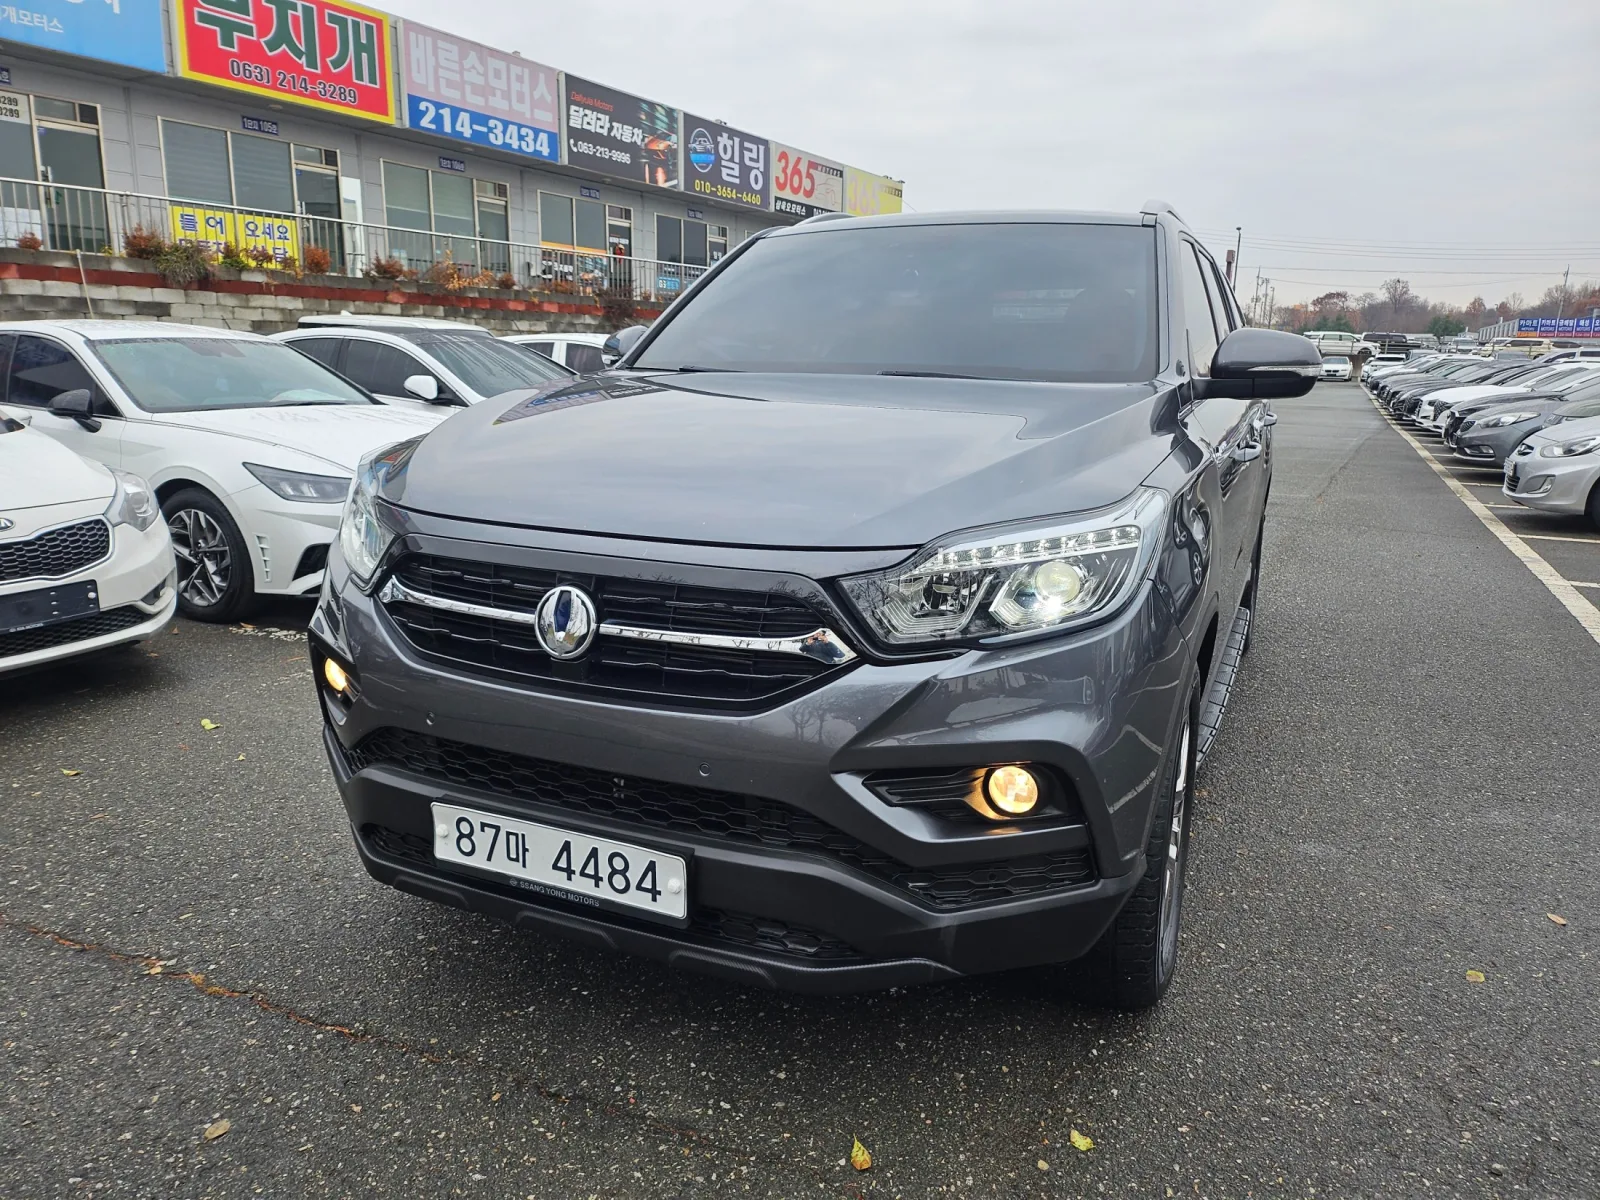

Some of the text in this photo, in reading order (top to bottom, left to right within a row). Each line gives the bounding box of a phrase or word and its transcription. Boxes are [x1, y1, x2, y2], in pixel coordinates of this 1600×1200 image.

[0, 5, 64, 33] 개모터스
[194, 0, 380, 88] 무지개
[229, 58, 357, 104] 063) 214-3289
[409, 32, 553, 122] 바른손모터스
[0, 95, 18, 107] 289
[418, 101, 550, 157] 214-3434
[569, 105, 643, 145] 달려라 자동차
[577, 141, 631, 164] 063-213-9996
[717, 132, 765, 190] 힐링
[816, 163, 841, 177] MOTORS
[694, 179, 761, 205] 010-3654-6460
[775, 151, 815, 199] 365
[245, 221, 289, 241] 오세요
[455, 816, 662, 902] 87마 4484
[520, 881, 600, 907] SSANG YONG MOTORS
